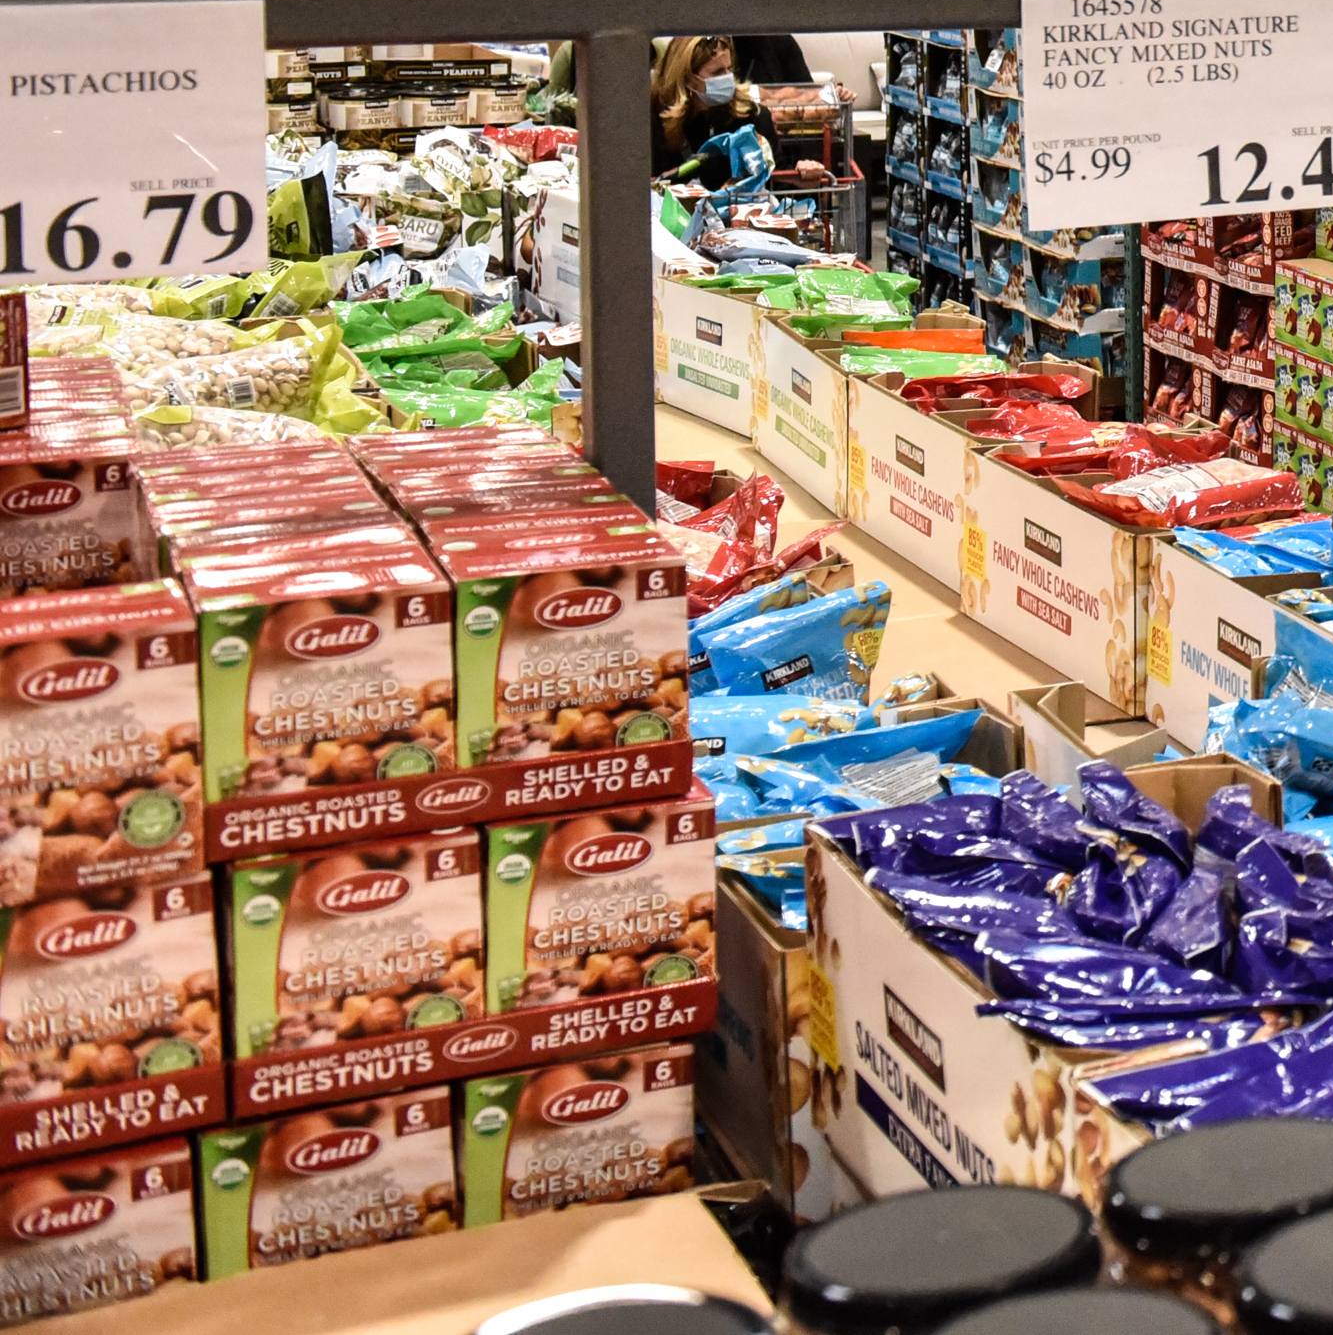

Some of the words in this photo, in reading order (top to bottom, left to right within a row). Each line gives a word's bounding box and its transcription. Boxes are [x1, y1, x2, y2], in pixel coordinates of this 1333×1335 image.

[1042, 22, 1164, 44] KIRKLAND
[1172, 15, 1299, 38] SIGNATURE
[1043, 46, 1123, 68] FANCY
[1132, 43, 1207, 63] MIXED
[1214, 39, 1273, 58] NUTS
[9, 69, 199, 96] PISTACHIOS
[1042, 71, 1067, 90] 40
[1074, 69, 1106, 88] OZ
[1147, 66, 1185, 88] (2.5
[1192, 63, 1239, 83] LBS)
[1034, 147, 1132, 187] $4.99
[130, 179, 167, 192] SELL
[172, 177, 215, 190] PRICE
[0, 190, 255, 275] 16.79
[1026, 522, 1061, 553] KIRKLAND
[993, 541, 1019, 575] FANCY
[1021, 556, 1052, 594] WHOLE
[1054, 576, 1099, 621] CASHEWS
[543, 595, 614, 621] Galil
[1021, 592, 1037, 610] WITH
[1038, 600, 1052, 620] SEA
[1053, 606, 1068, 632] SALT
[519, 650, 639, 678] ROASTED
[504, 668, 654, 701] CHESTNUTS
[523, 757, 627, 786] SHELLED
[634, 754, 649, 770] &
[505, 779, 587, 806] READY
[592, 775, 624, 795] TO
[630, 767, 675, 788] EAT
[220, 801, 406, 848] CHESTNUTS
